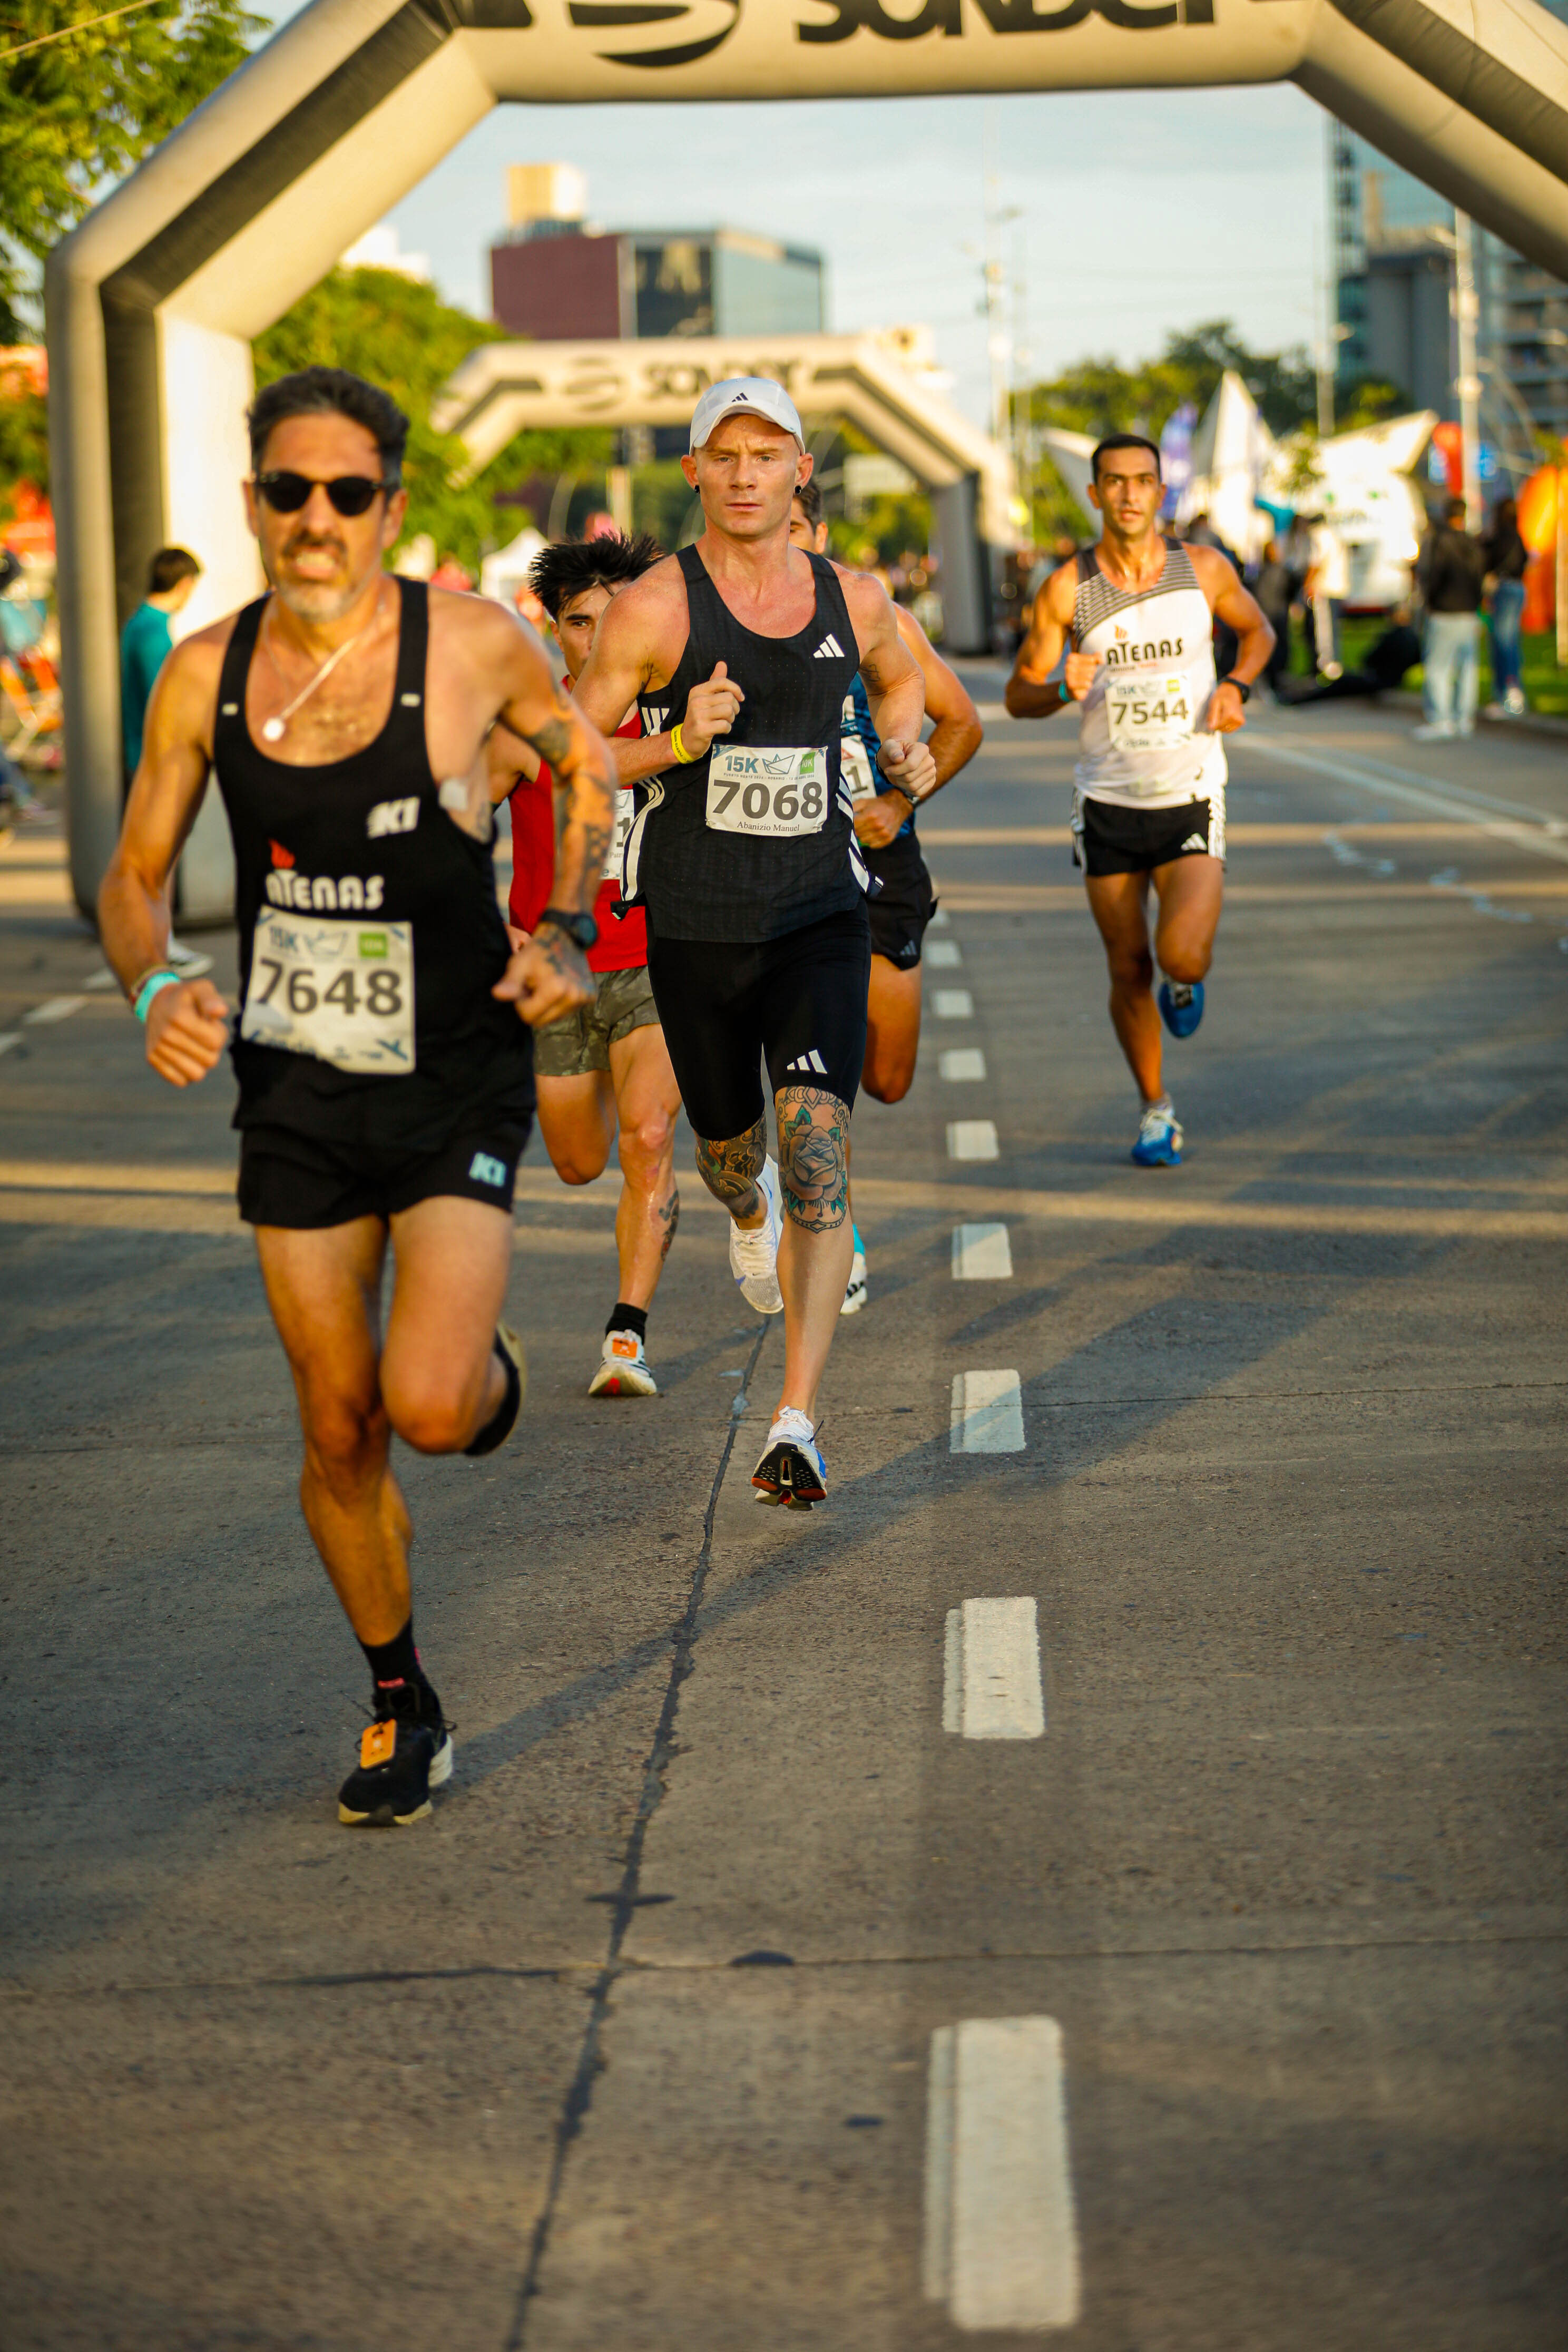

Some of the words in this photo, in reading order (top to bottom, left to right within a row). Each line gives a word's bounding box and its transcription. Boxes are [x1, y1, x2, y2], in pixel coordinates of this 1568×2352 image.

[1107, 638, 1183, 665] ATENAS
[1112, 699, 1188, 725] 7544
[725, 755, 759, 773] 15K
[801, 759, 813, 768] 10K
[713, 780, 822, 820] 7068
[737, 821, 771, 831] Abanizio
[773, 823, 800, 832] Manuel
[265, 869, 384, 910] ATENAS
[256, 957, 402, 1016] 7648
